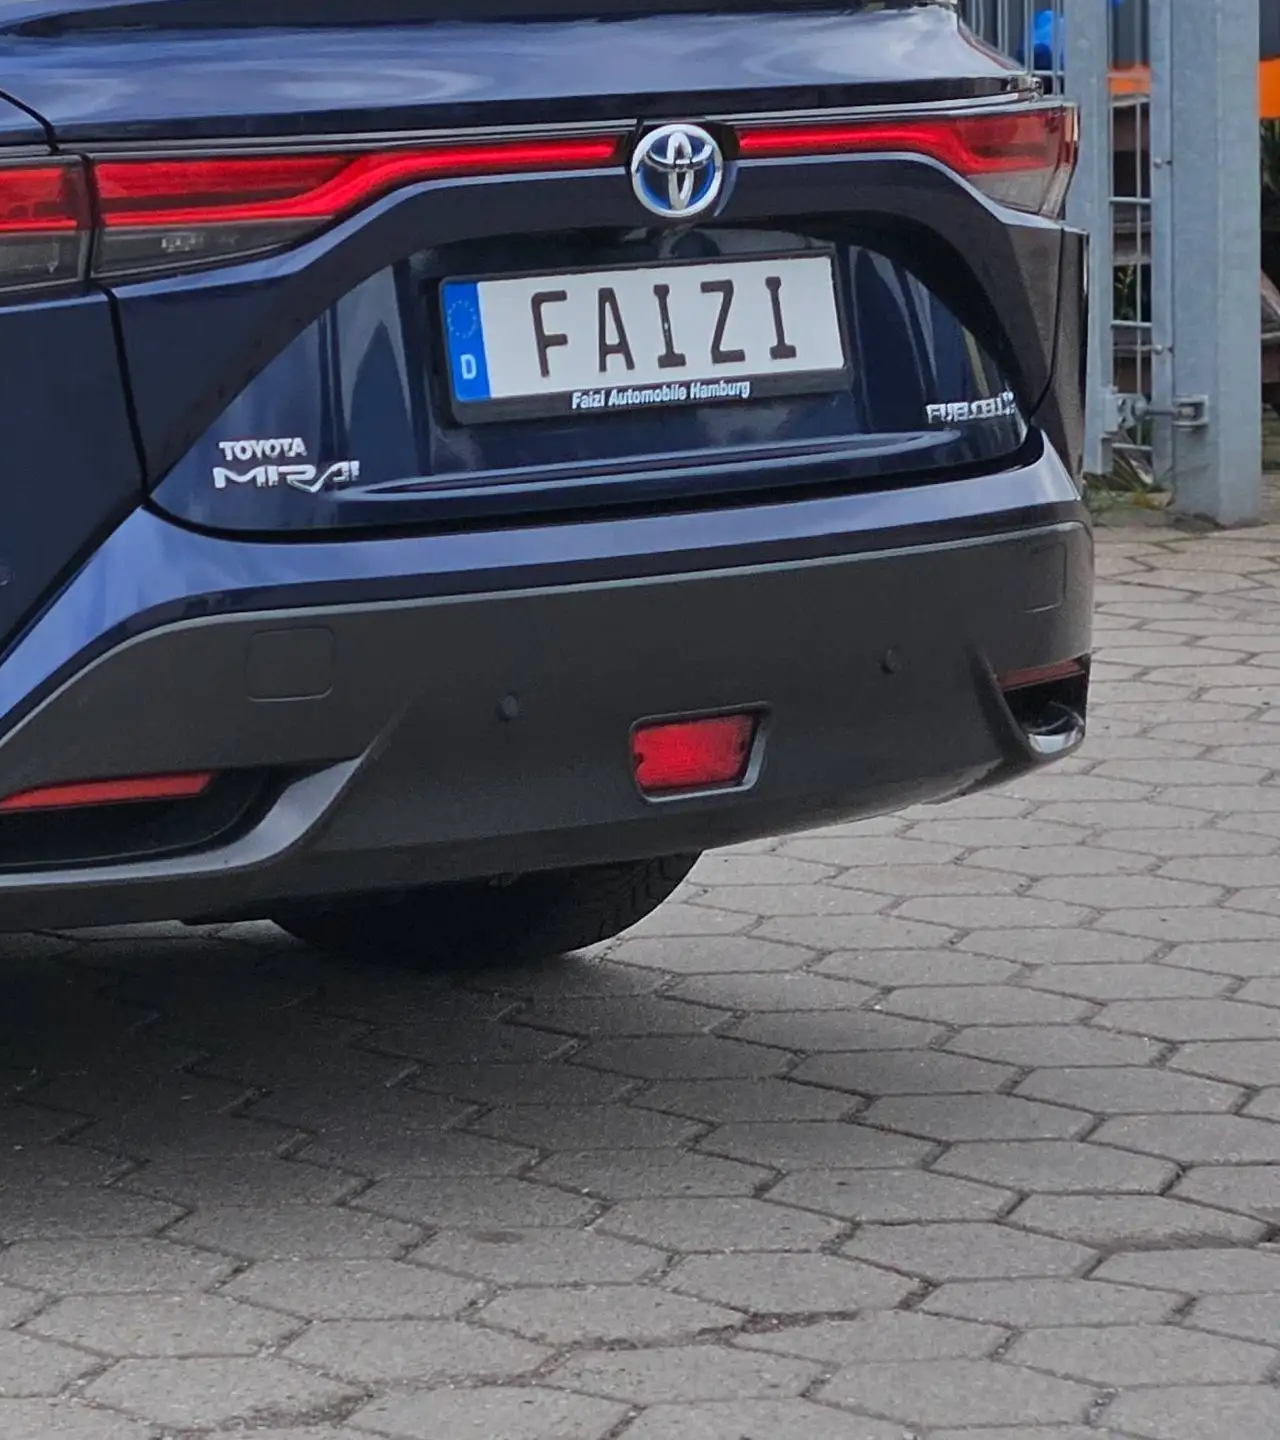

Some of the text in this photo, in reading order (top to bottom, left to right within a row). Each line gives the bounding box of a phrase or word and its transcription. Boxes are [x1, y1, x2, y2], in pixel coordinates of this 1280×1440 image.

[530, 275, 798, 378] FAIZI
[460, 353, 477, 380] D
[571, 380, 750, 410] Faizi Automobile Hamburg
[218, 437, 307, 460] TOYOTA
[212, 460, 360, 493] MIRAI
